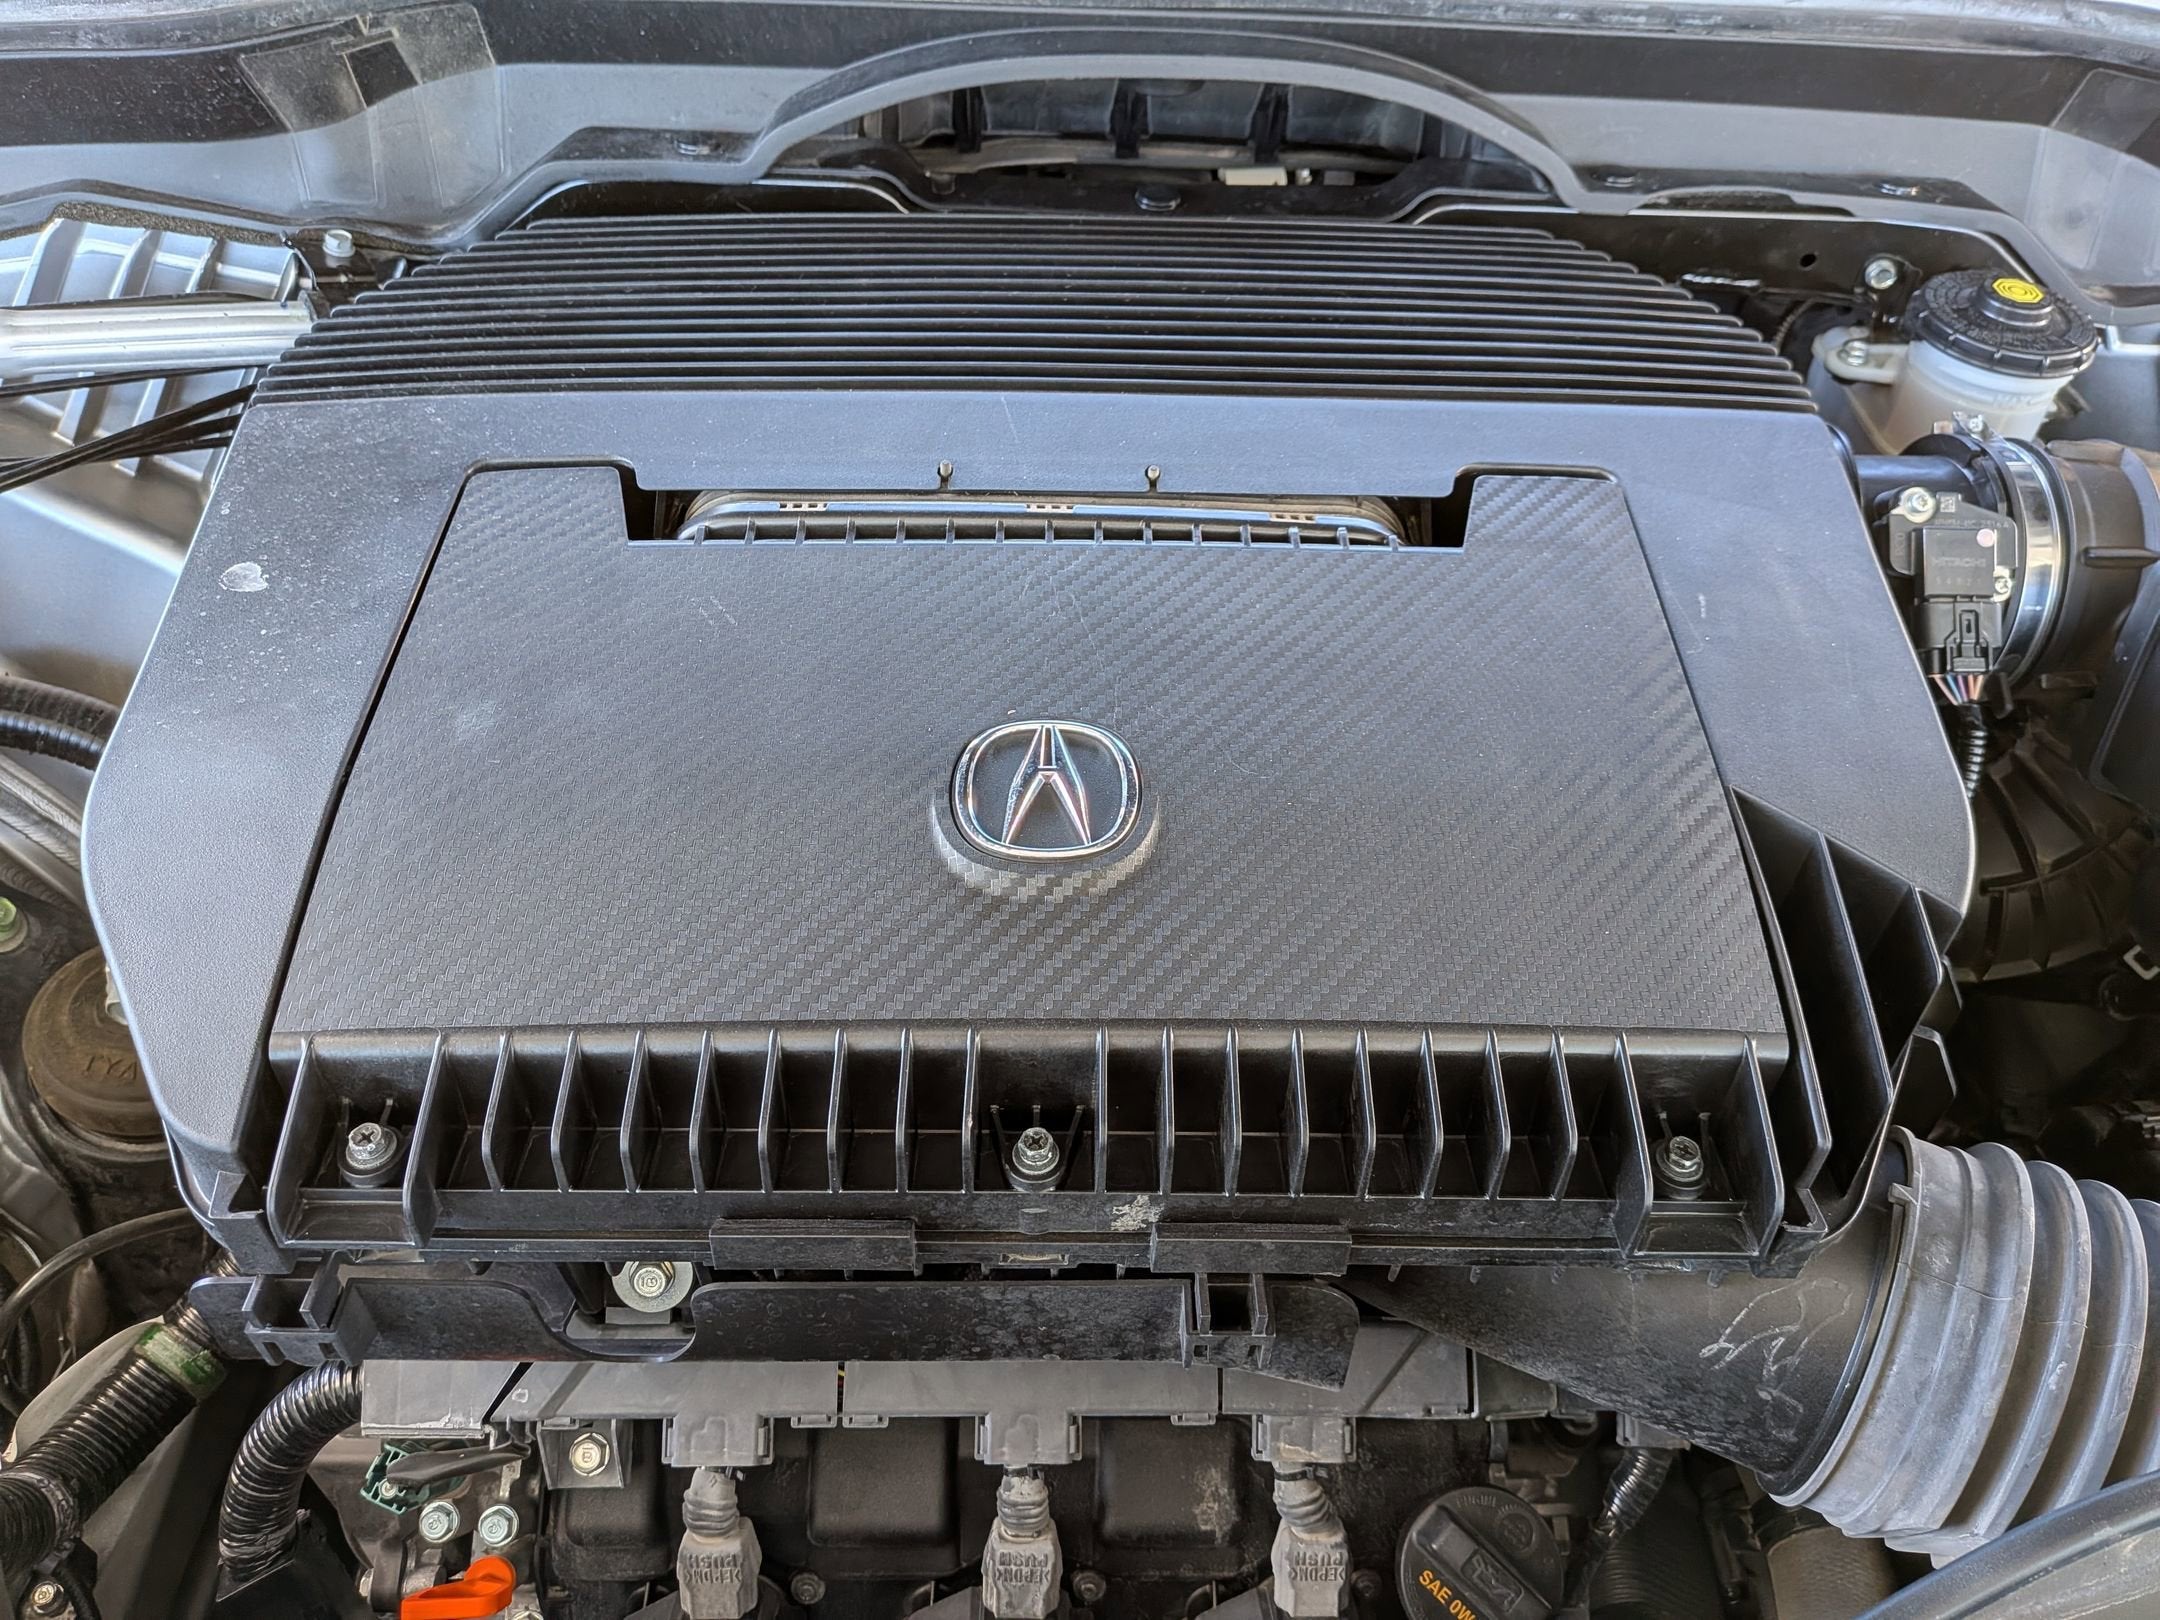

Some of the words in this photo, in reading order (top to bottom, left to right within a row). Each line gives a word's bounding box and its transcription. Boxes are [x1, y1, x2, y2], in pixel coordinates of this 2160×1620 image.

[688, 1554, 738, 1569] PUSH
[1294, 1551, 1344, 1566] PUSH
[1419, 1570, 1452, 1606] SAE
